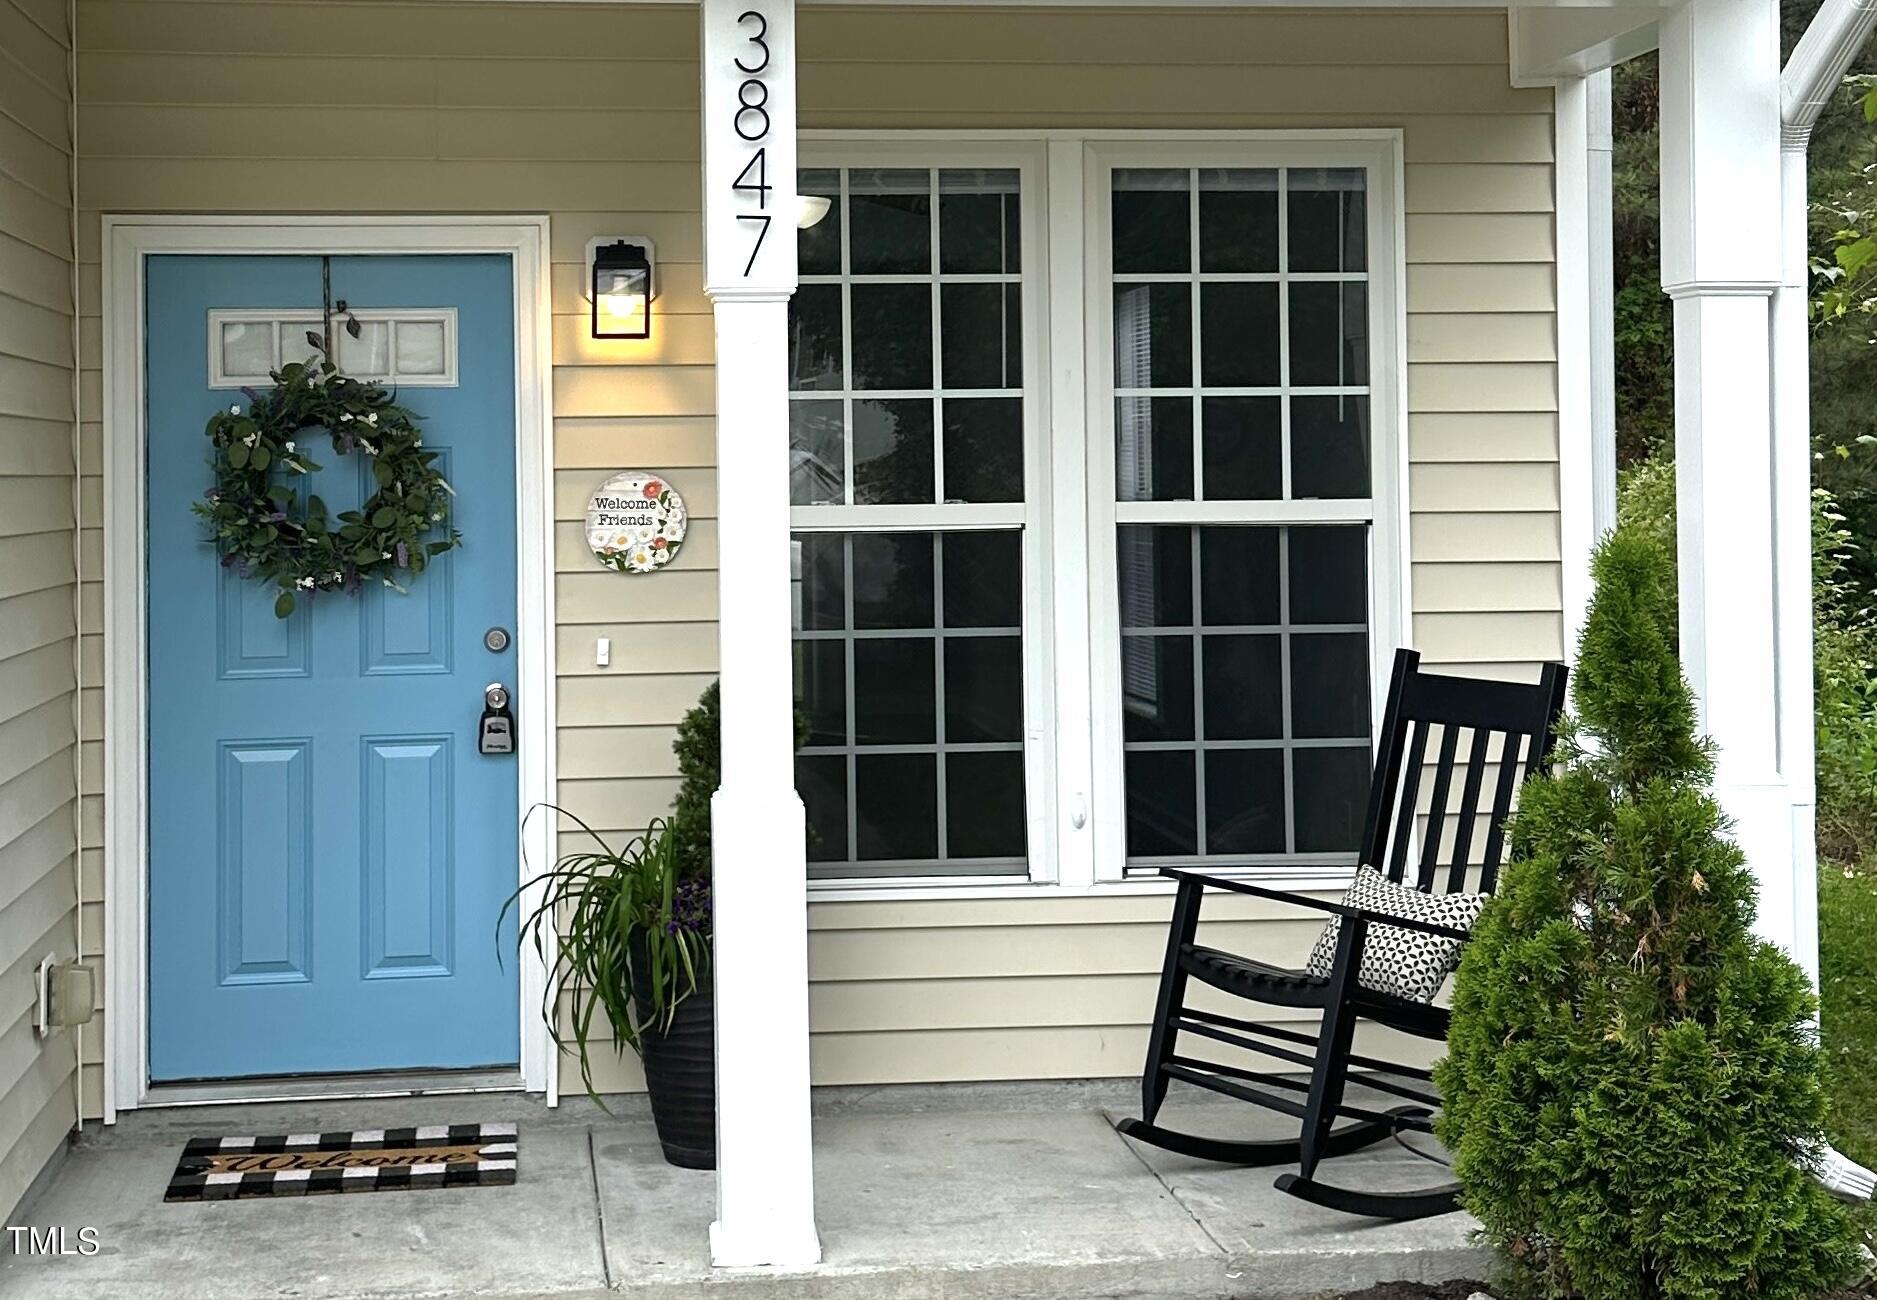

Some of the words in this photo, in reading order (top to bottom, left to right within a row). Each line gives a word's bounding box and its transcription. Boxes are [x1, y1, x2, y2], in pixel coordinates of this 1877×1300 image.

[731, 10, 773, 278] 3847
[595, 497, 657, 510] Welcome
[597, 514, 653, 526] Friends
[225, 1151, 467, 1172] Welcome
